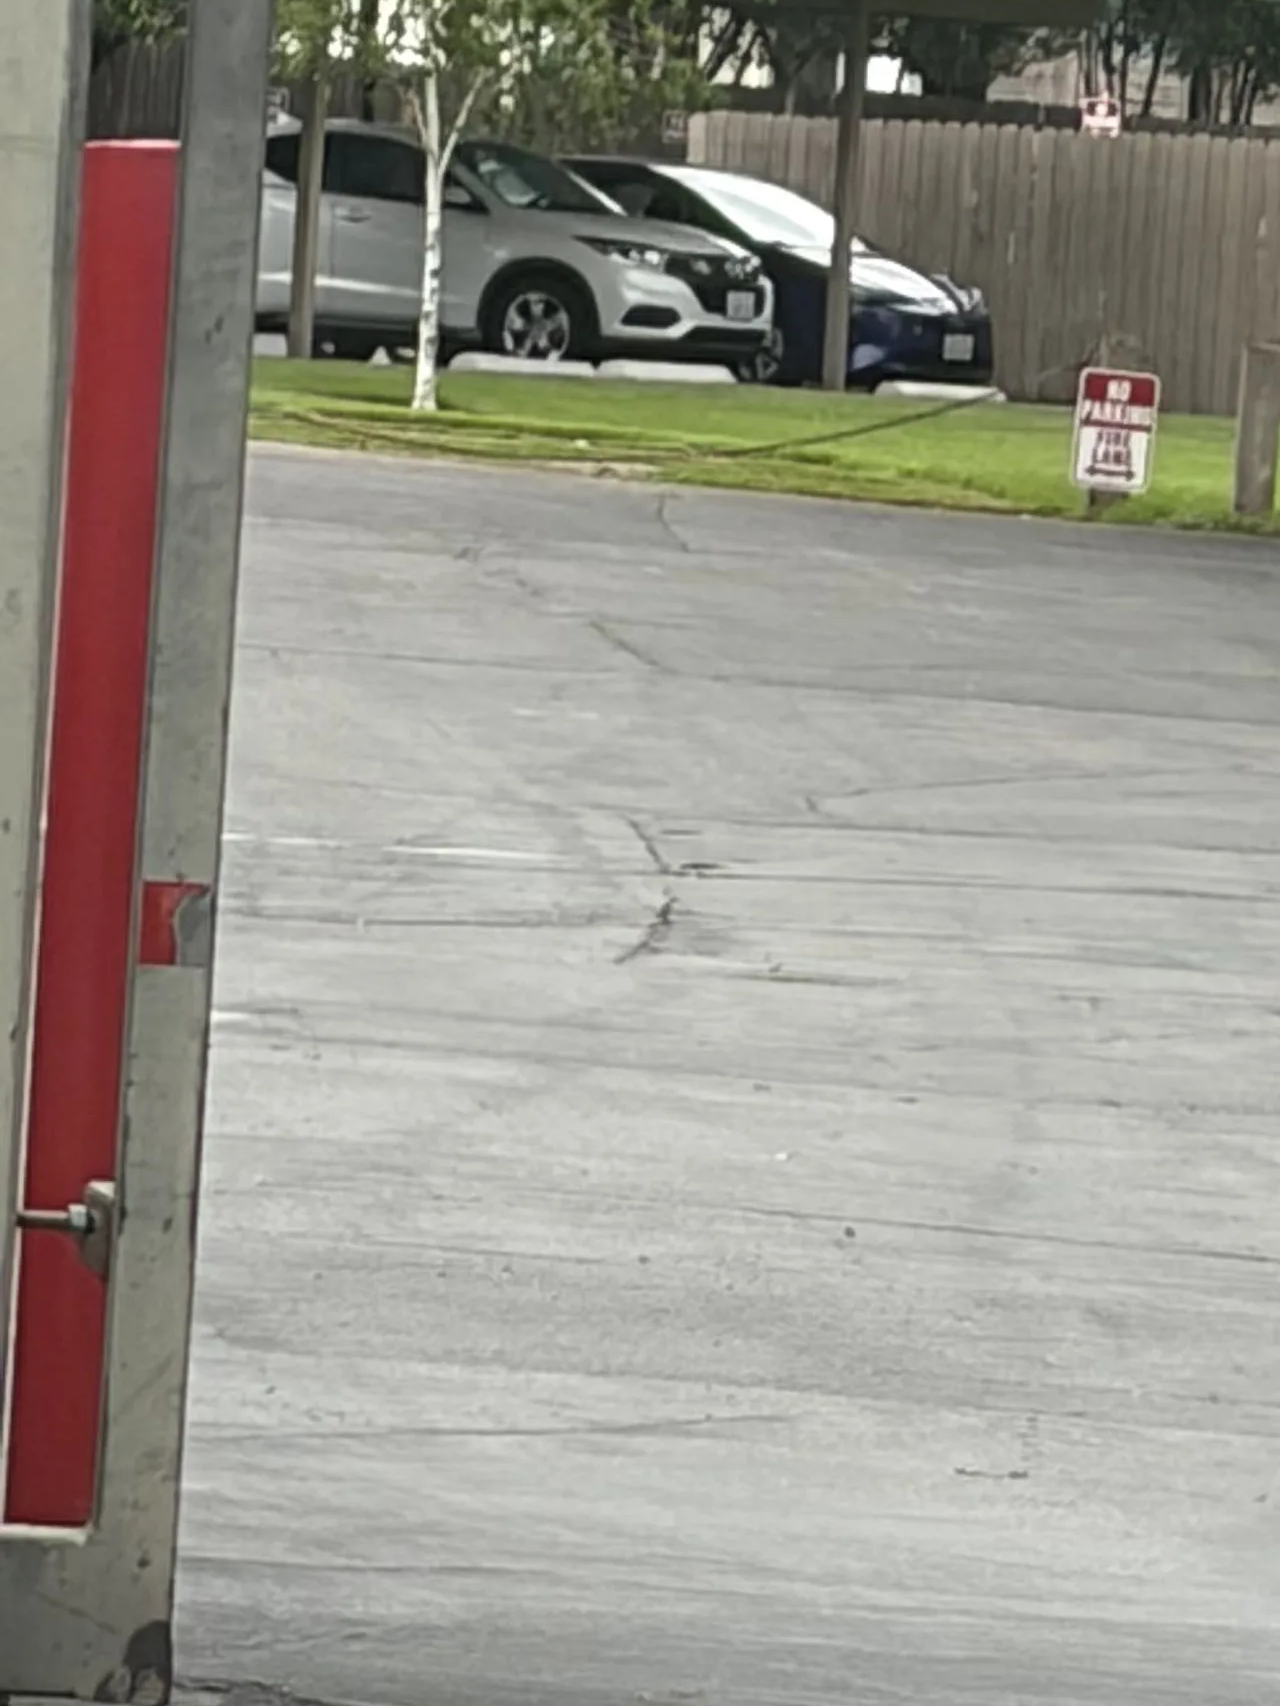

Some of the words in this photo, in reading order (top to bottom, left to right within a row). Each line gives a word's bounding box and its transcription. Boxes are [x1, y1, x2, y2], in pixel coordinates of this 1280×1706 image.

[1106, 380, 1132, 402] NO
[1082, 399, 1151, 425] PARKING
[1097, 430, 1131, 448] FIRE
[1092, 447, 1131, 468] LANE
